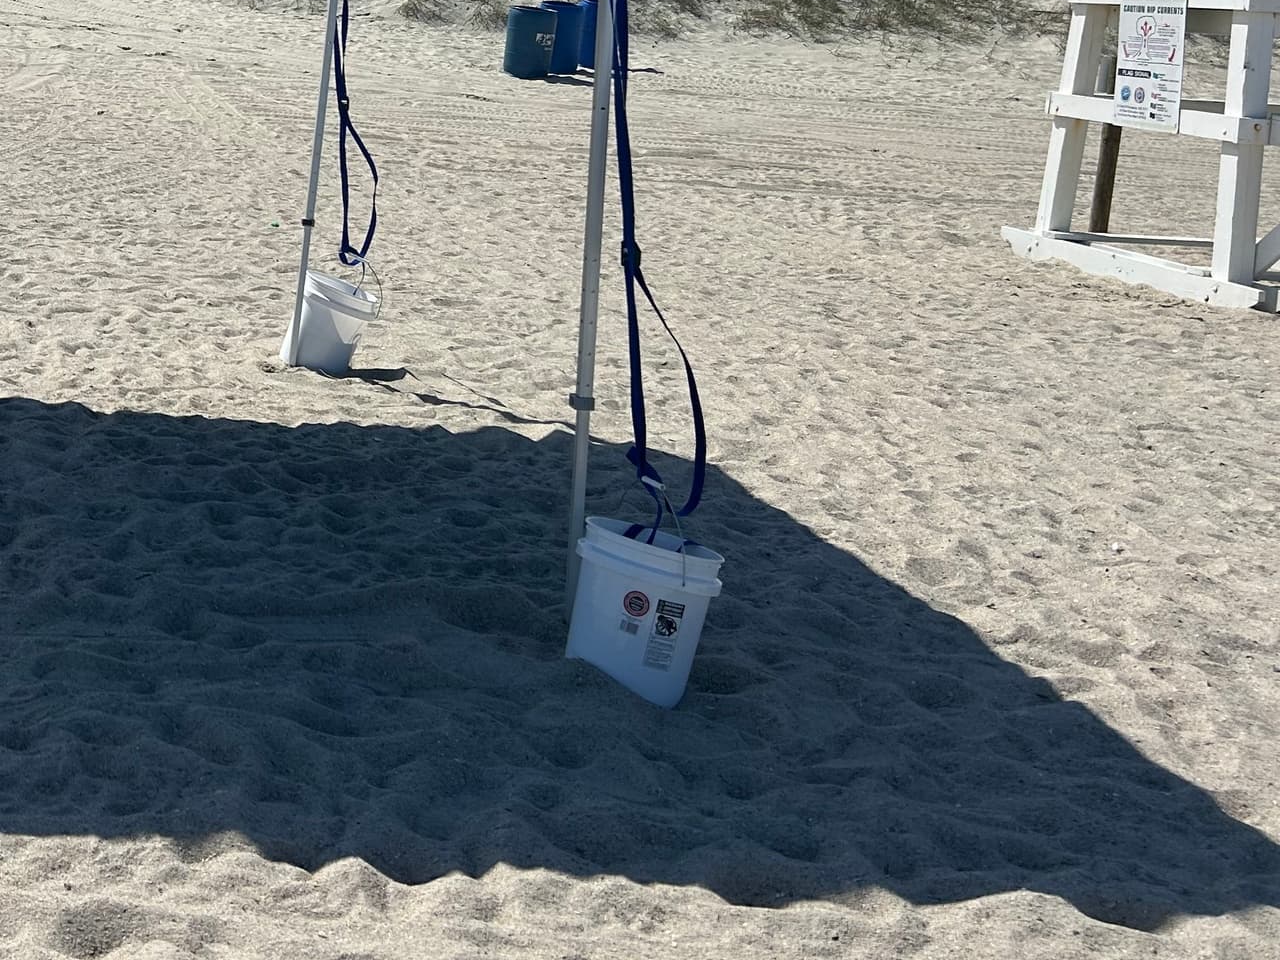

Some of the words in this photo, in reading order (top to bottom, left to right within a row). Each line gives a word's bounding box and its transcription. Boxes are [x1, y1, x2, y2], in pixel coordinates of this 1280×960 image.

[1123, 5, 1145, 13] CAUTION
[1147, 6, 1156, 14] RIP
[1157, 6, 1184, 15] CURRENTS
